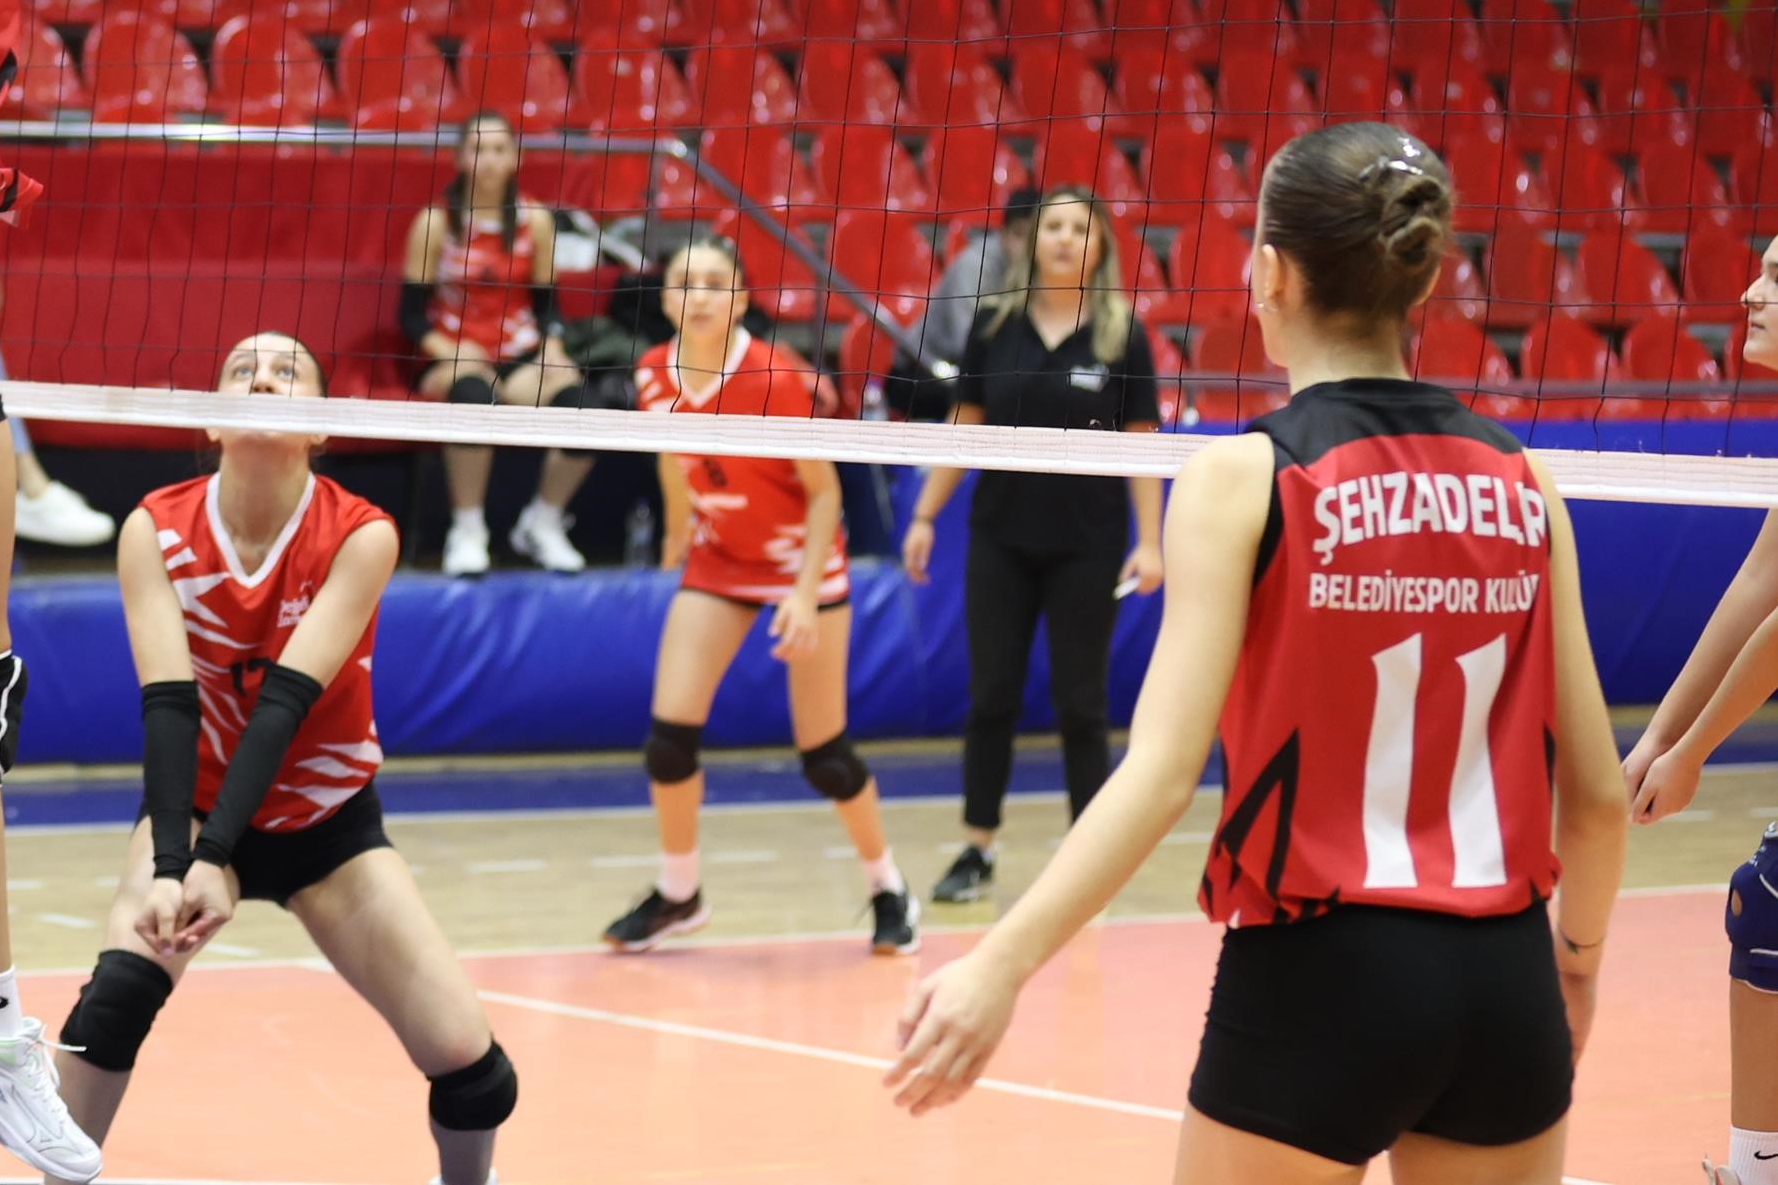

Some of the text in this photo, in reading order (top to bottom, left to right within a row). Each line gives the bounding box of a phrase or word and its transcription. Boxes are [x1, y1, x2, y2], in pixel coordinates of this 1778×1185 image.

[1313, 471, 1545, 566] ŞEHZADELR
[1309, 569, 1478, 613] BELEDİYESPOR
[1363, 632, 1507, 888] 11
